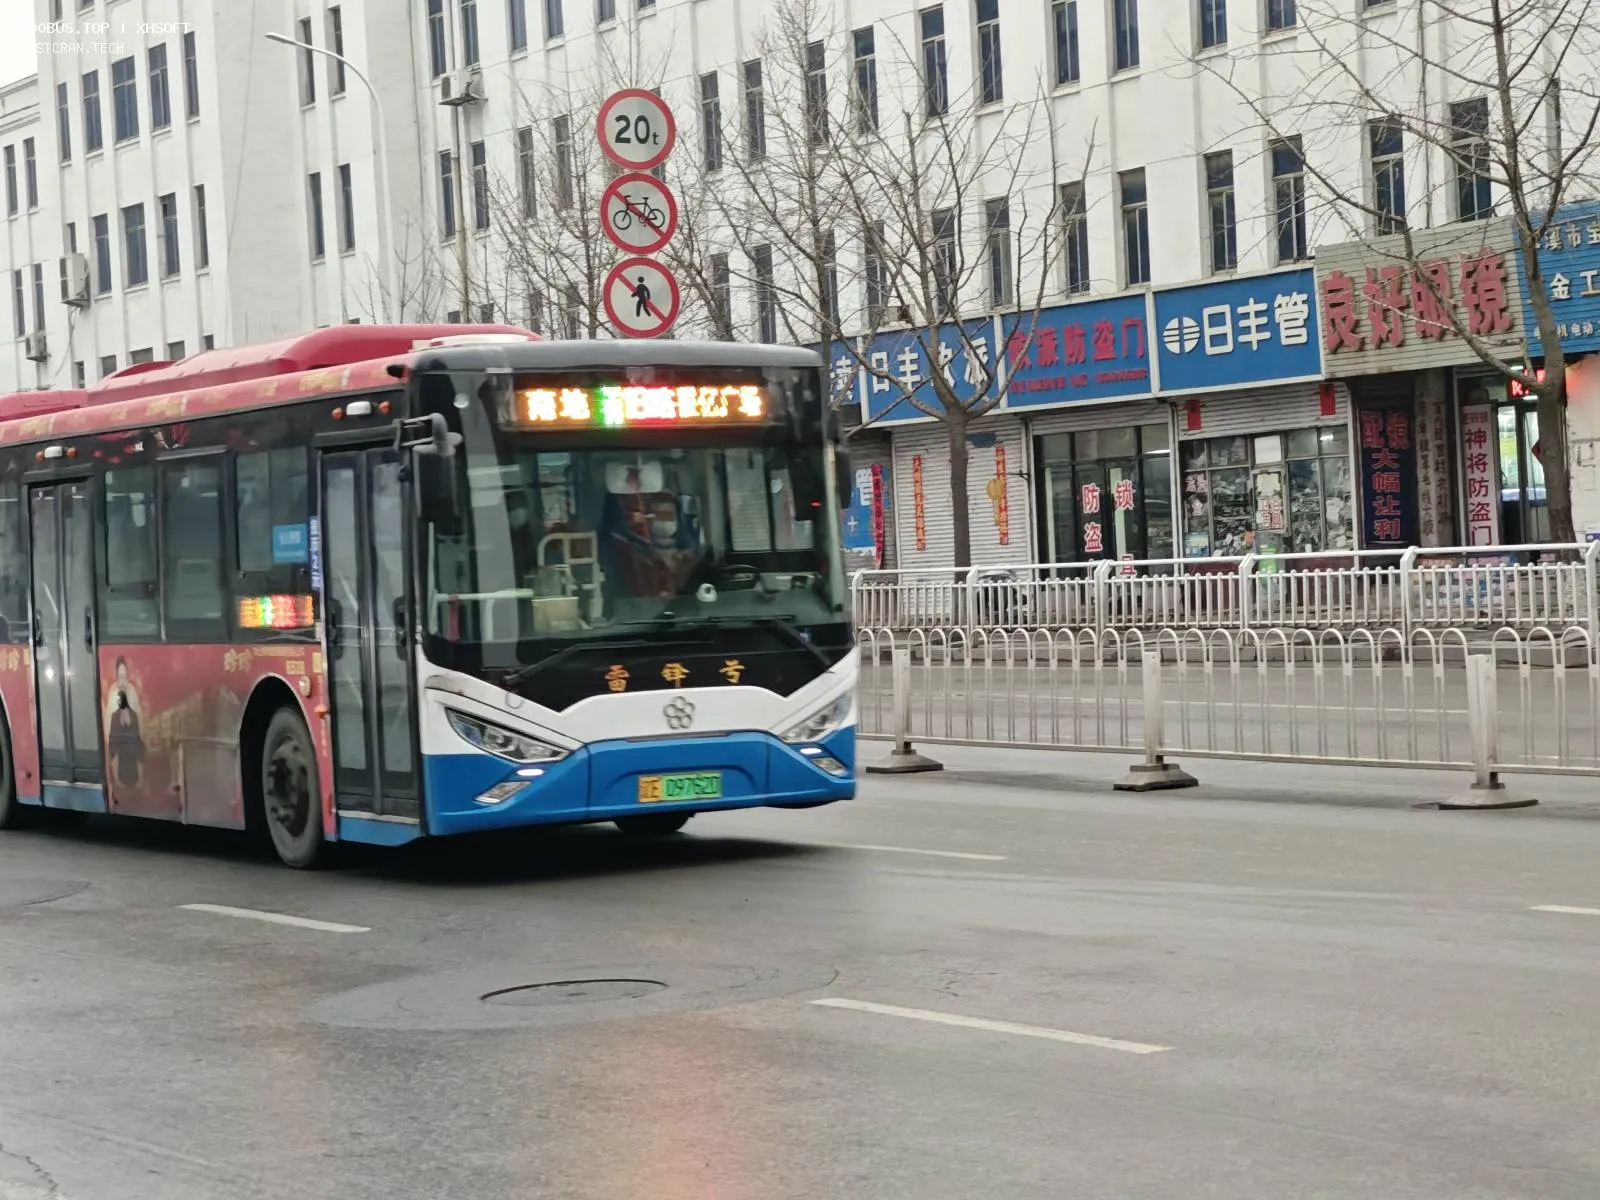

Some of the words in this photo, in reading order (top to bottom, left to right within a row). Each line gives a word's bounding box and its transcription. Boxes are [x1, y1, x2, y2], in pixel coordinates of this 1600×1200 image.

[1202, 291, 1309, 356] 日丰管
[1322, 246, 1515, 354] 良好眼镜
